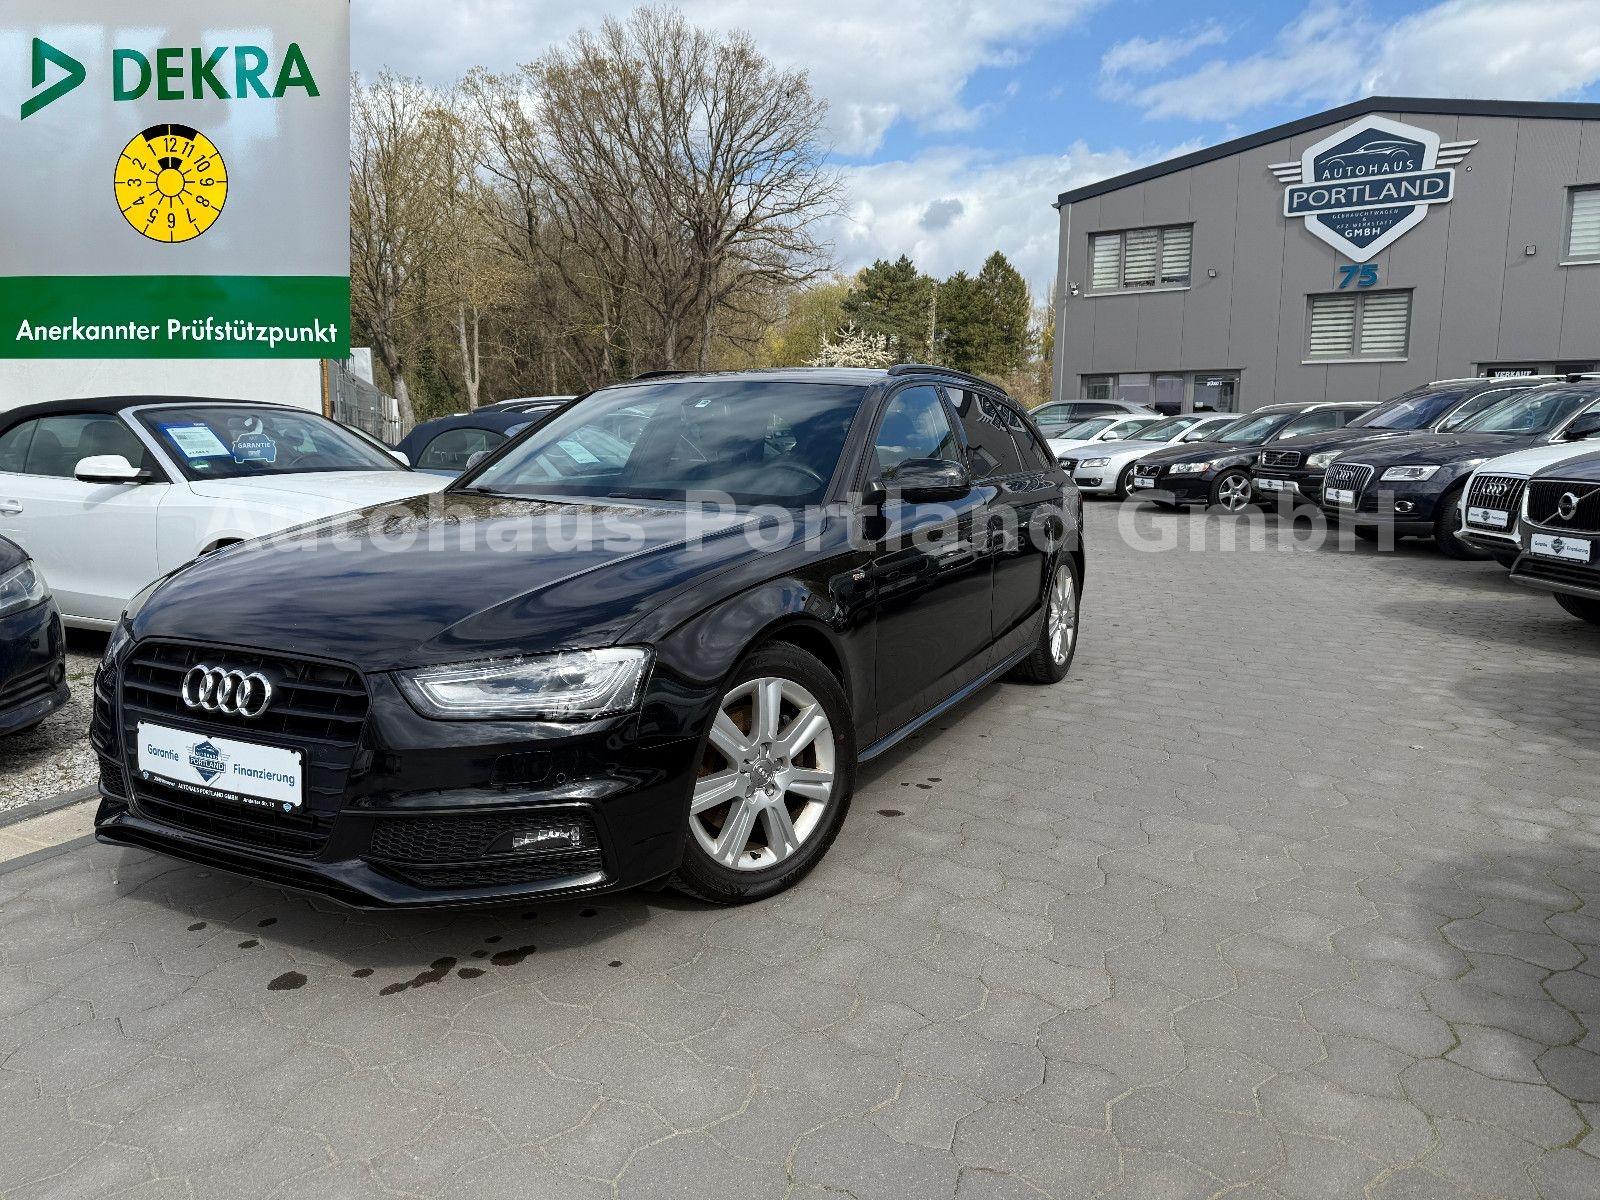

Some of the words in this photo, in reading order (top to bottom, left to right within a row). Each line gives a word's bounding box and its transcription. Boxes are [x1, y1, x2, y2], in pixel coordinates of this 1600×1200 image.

[1322, 159, 1414, 180] AUTOHAUS
[1292, 178, 1444, 208] PORTLAND
[1344, 227, 1381, 237] GMBH
[1339, 264, 1378, 289] 75
[147, 744, 179, 762] Garantie
[190, 757, 224, 771] PORTLAND
[233, 763, 295, 787] Finanzierung
